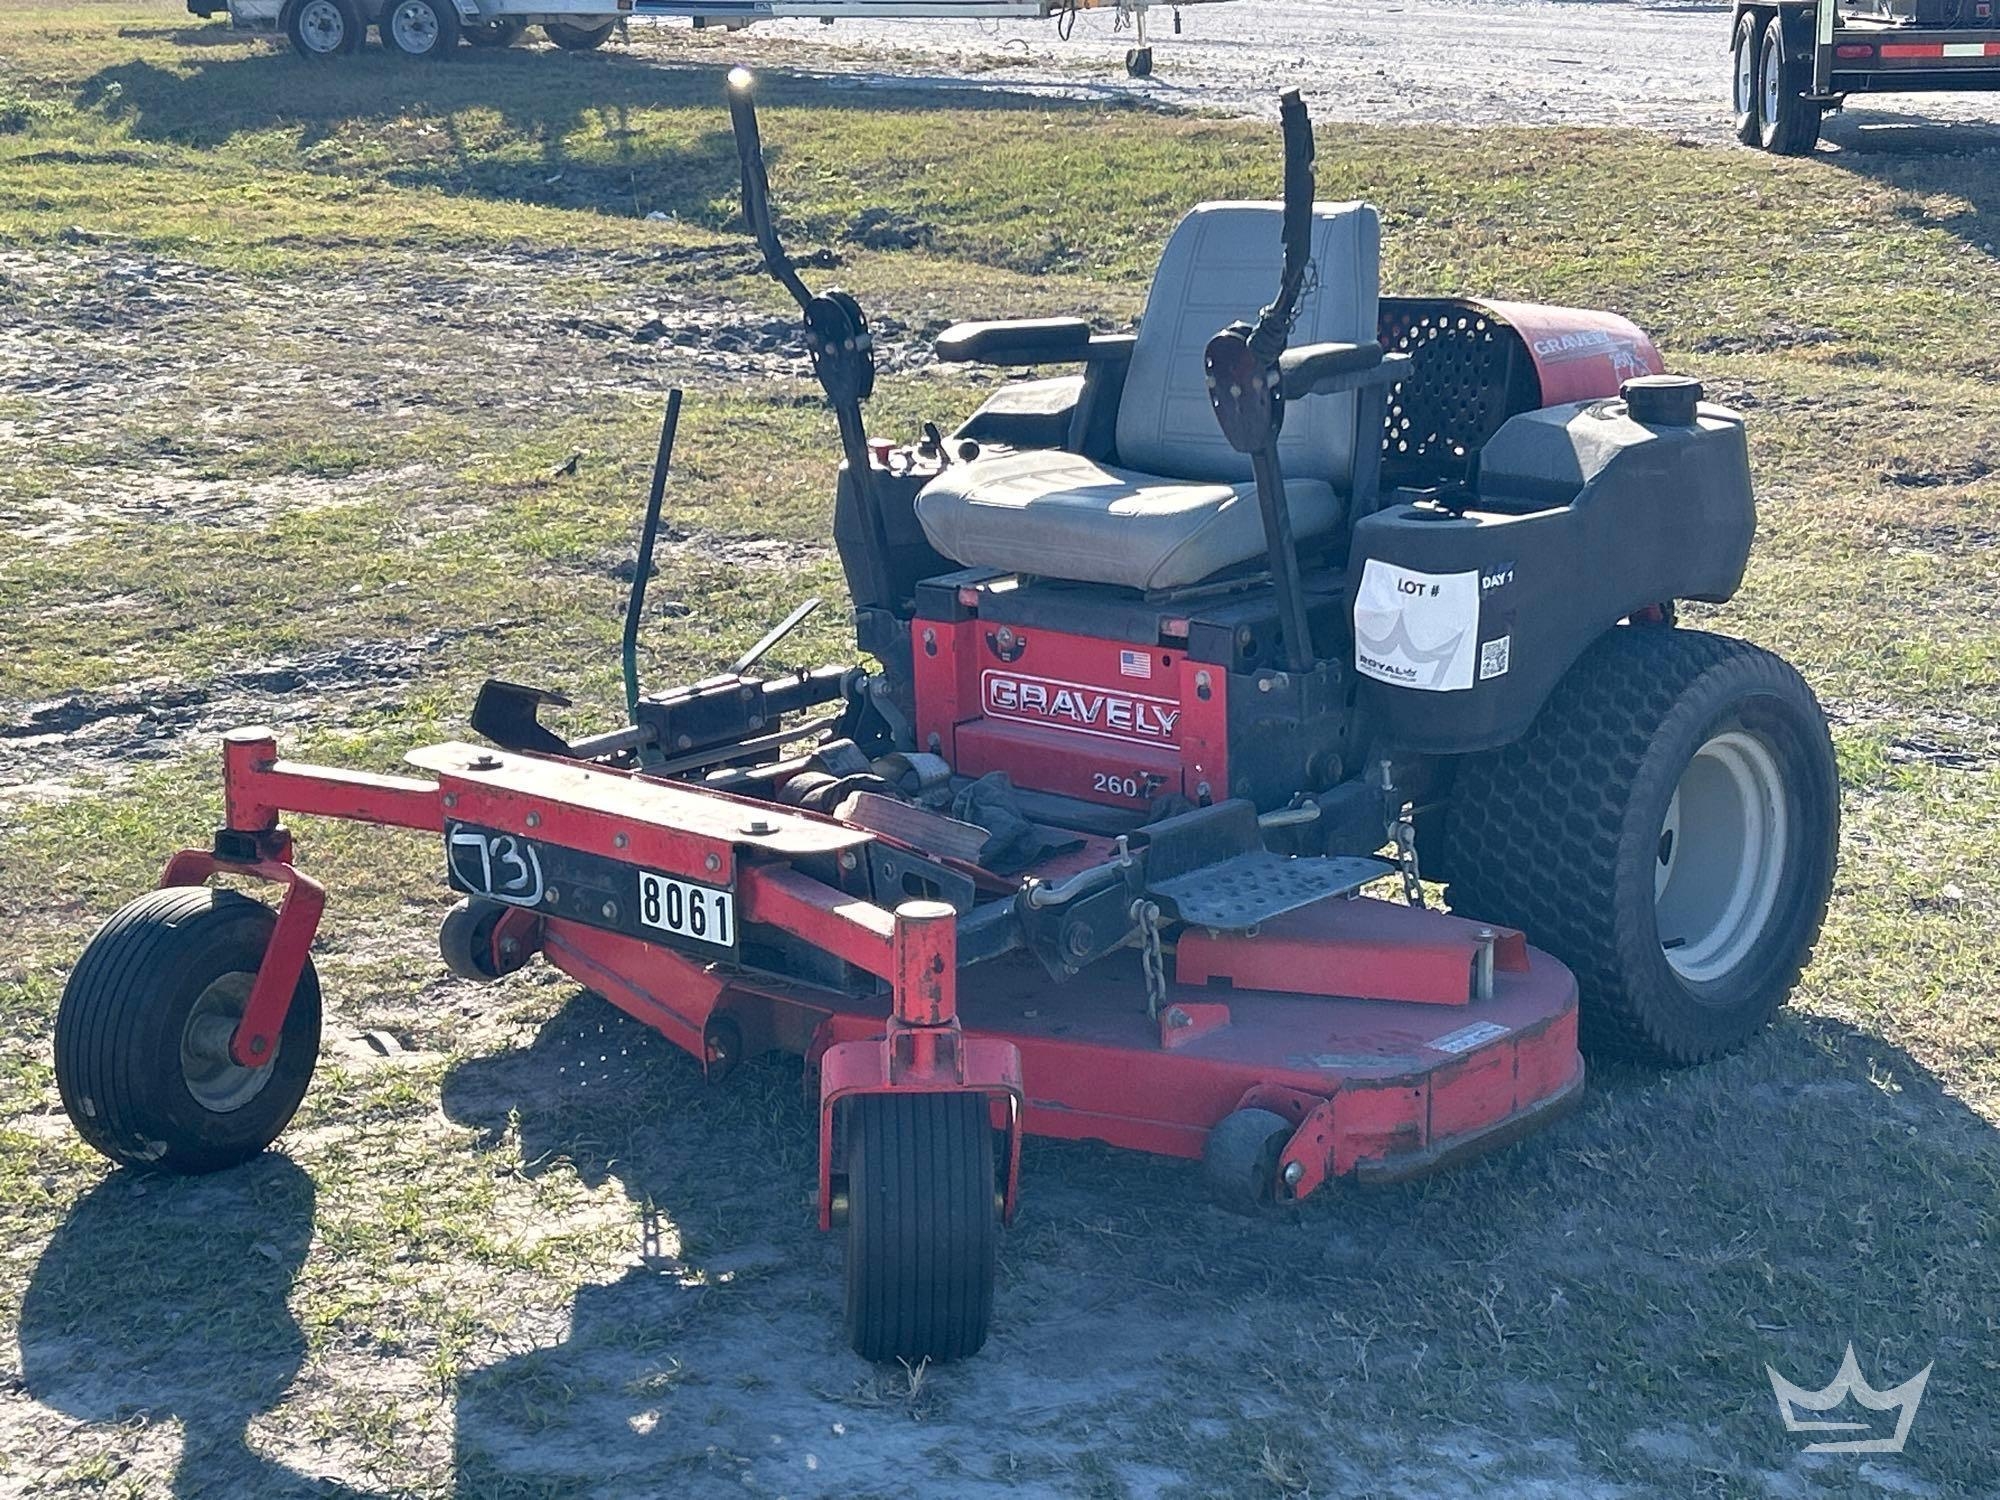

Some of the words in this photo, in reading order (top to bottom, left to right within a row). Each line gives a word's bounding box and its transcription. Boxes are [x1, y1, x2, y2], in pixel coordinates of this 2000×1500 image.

[1397, 578, 1426, 597] LOT
[1431, 585, 1440, 597] #
[1482, 573, 1506, 590] DAY
[1506, 570, 1514, 583] 1
[1360, 655, 1403, 675] ROYAL
[988, 677, 1181, 738] GRAVELY
[643, 877, 728, 942] 8061
